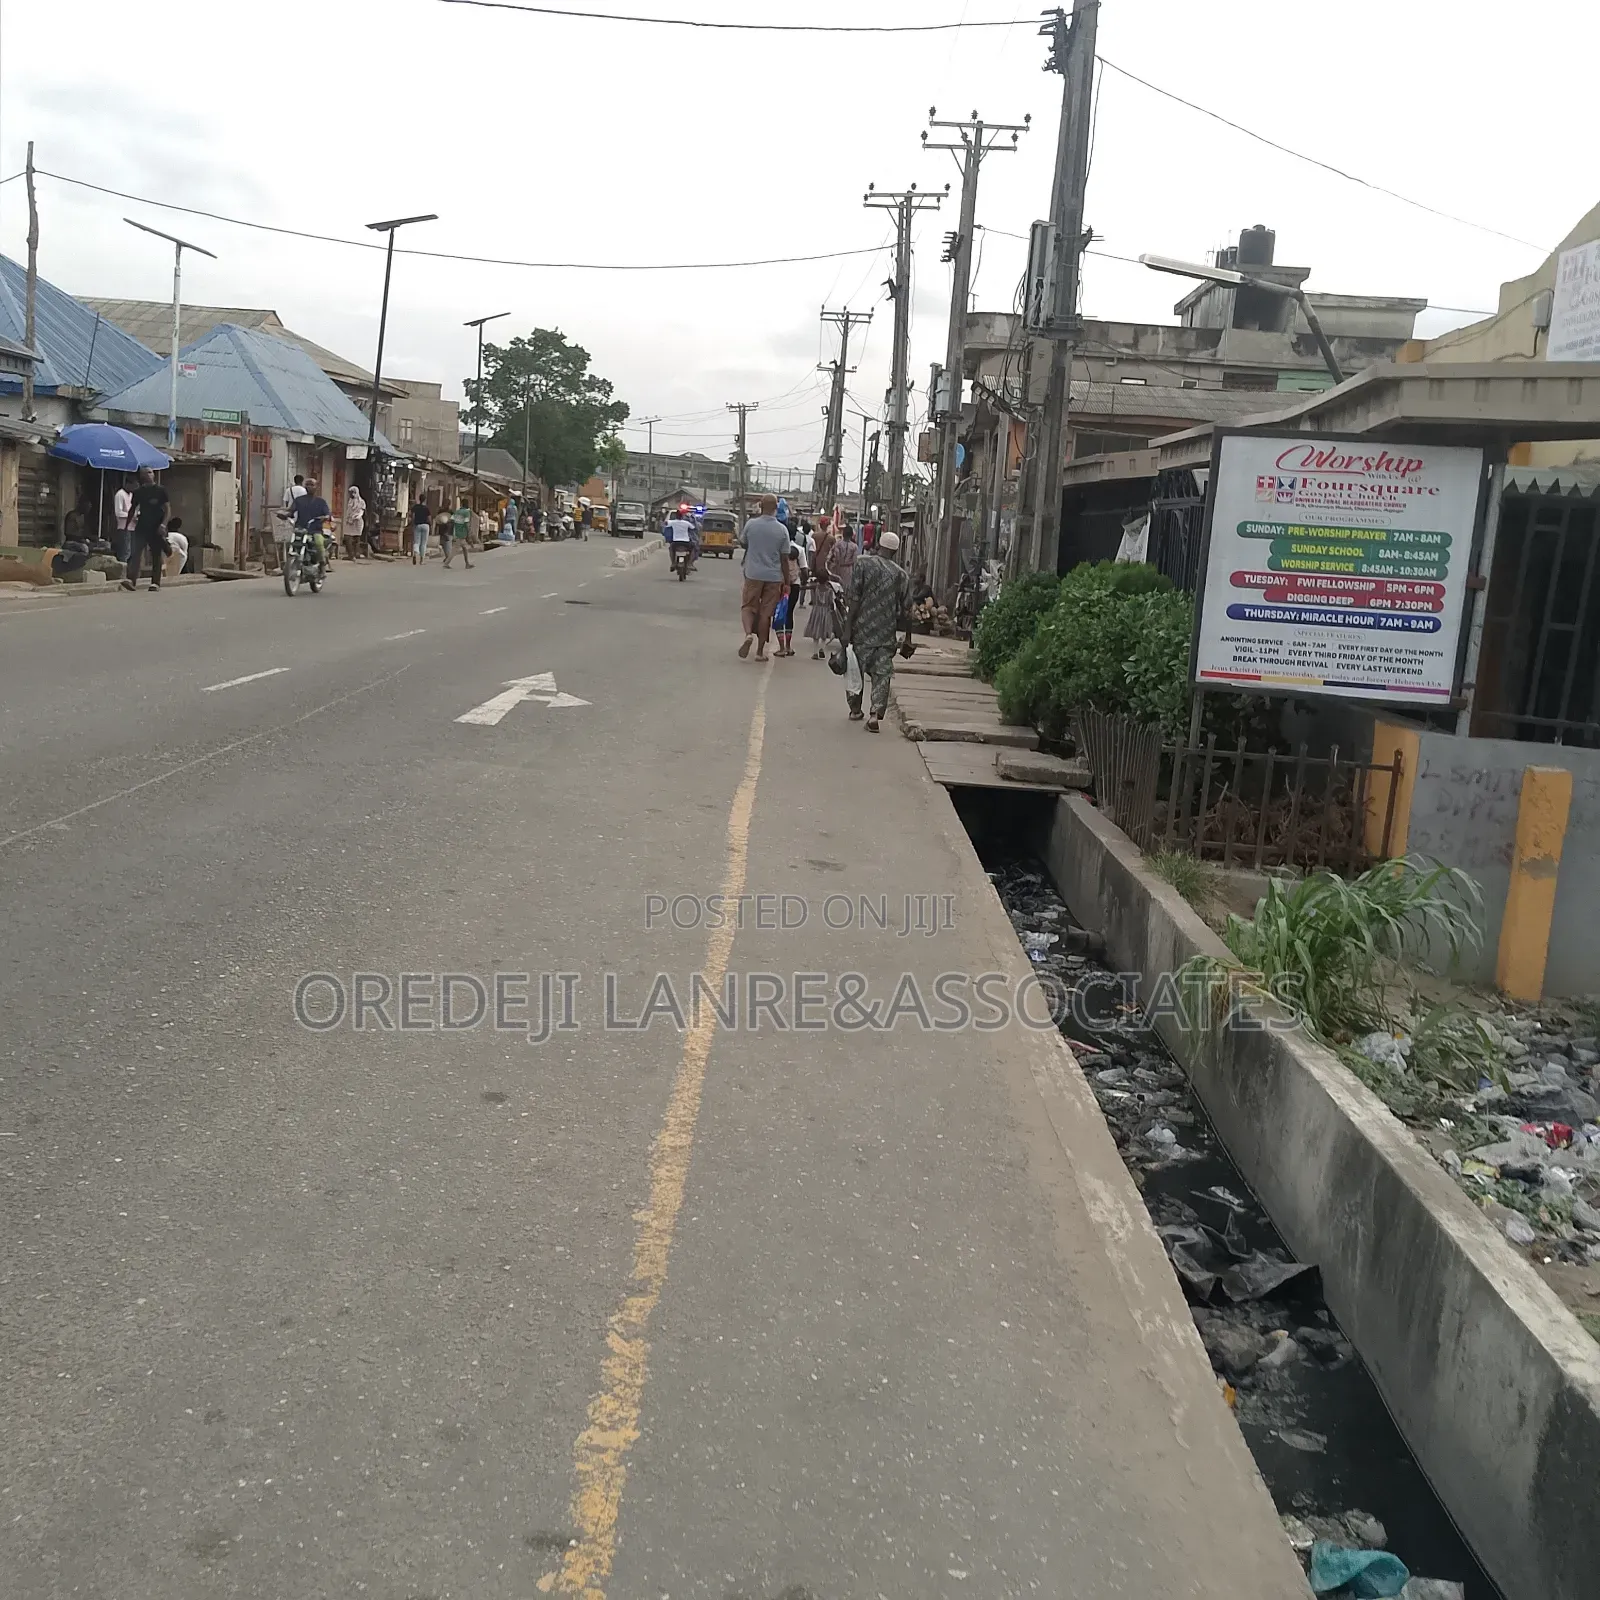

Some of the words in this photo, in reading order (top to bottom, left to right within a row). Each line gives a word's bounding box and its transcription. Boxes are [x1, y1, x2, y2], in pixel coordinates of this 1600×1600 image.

[1275, 444, 1424, 478] Worship
[1299, 490, 1343, 498] Gospel
[1348, 492, 1397, 501] Church
[1301, 477, 1440, 496] Foursquare
[1325, 516, 1385, 524] PROGRAMMES
[1246, 523, 1285, 535] SUNDAY:
[1287, 526, 1351, 538] PRE-WORSHIP
[1351, 530, 1387, 541] PRAYER
[1393, 532, 1414, 542] 7AM
[1420, 534, 1441, 544] 8AM
[1291, 543, 1328, 555] SUNDAY
[1328, 545, 1364, 557] SCHOOL
[1403, 550, 1439, 561] 8:45AM
[1281, 558, 1319, 570] WORSHIP
[1320, 561, 1355, 572] SERVICE
[1361, 564, 1393, 575] 8:45AM
[1400, 566, 1437, 577] 10:30AM
[1244, 574, 1288, 586] TUESDAY:
[1297, 578, 1316, 588] FWI
[1317, 578, 1376, 591] FELLOWSHIP
[1386, 583, 1407, 594] 5PM
[1414, 585, 1435, 595] 6PM
[1287, 592, 1328, 604] DIGGING
[1328, 595, 1355, 606] DEEP
[1369, 598, 1391, 608] 6PM
[1395, 599, 1433, 611] 7:30PM
[1244, 608, 1299, 621] THURSDAY:
[1300, 612, 1344, 623] MIRACLE
[1345, 614, 1374, 626] HOUR
[1380, 617, 1402, 628] 7AM
[1410, 619, 1434, 630] 9AM
[1220, 635, 1256, 644] ANOINTING
[1257, 638, 1283, 646] SERVICE
[1338, 643, 1359, 651] EVERY
[1360, 645, 1378, 653] FIRST
[1235, 645, 1254, 653] VIGIL
[1288, 649, 1313, 658] EVERY
[1314, 651, 1337, 659] THIRD
[1338, 653, 1365, 661] FRIDAY
[1379, 656, 1394, 664] THE
[1395, 657, 1424, 665] MONTH
[1233, 655, 1258, 663] BREAK
[1259, 657, 1295, 666] THROUGH
[1297, 660, 1328, 668] REVIVAL
[1336, 662, 1361, 671] EVERY
[1362, 664, 1382, 673] LAST
[1384, 667, 1423, 676] WEEKEND
[1395, 678, 1425, 686] Hebrews
